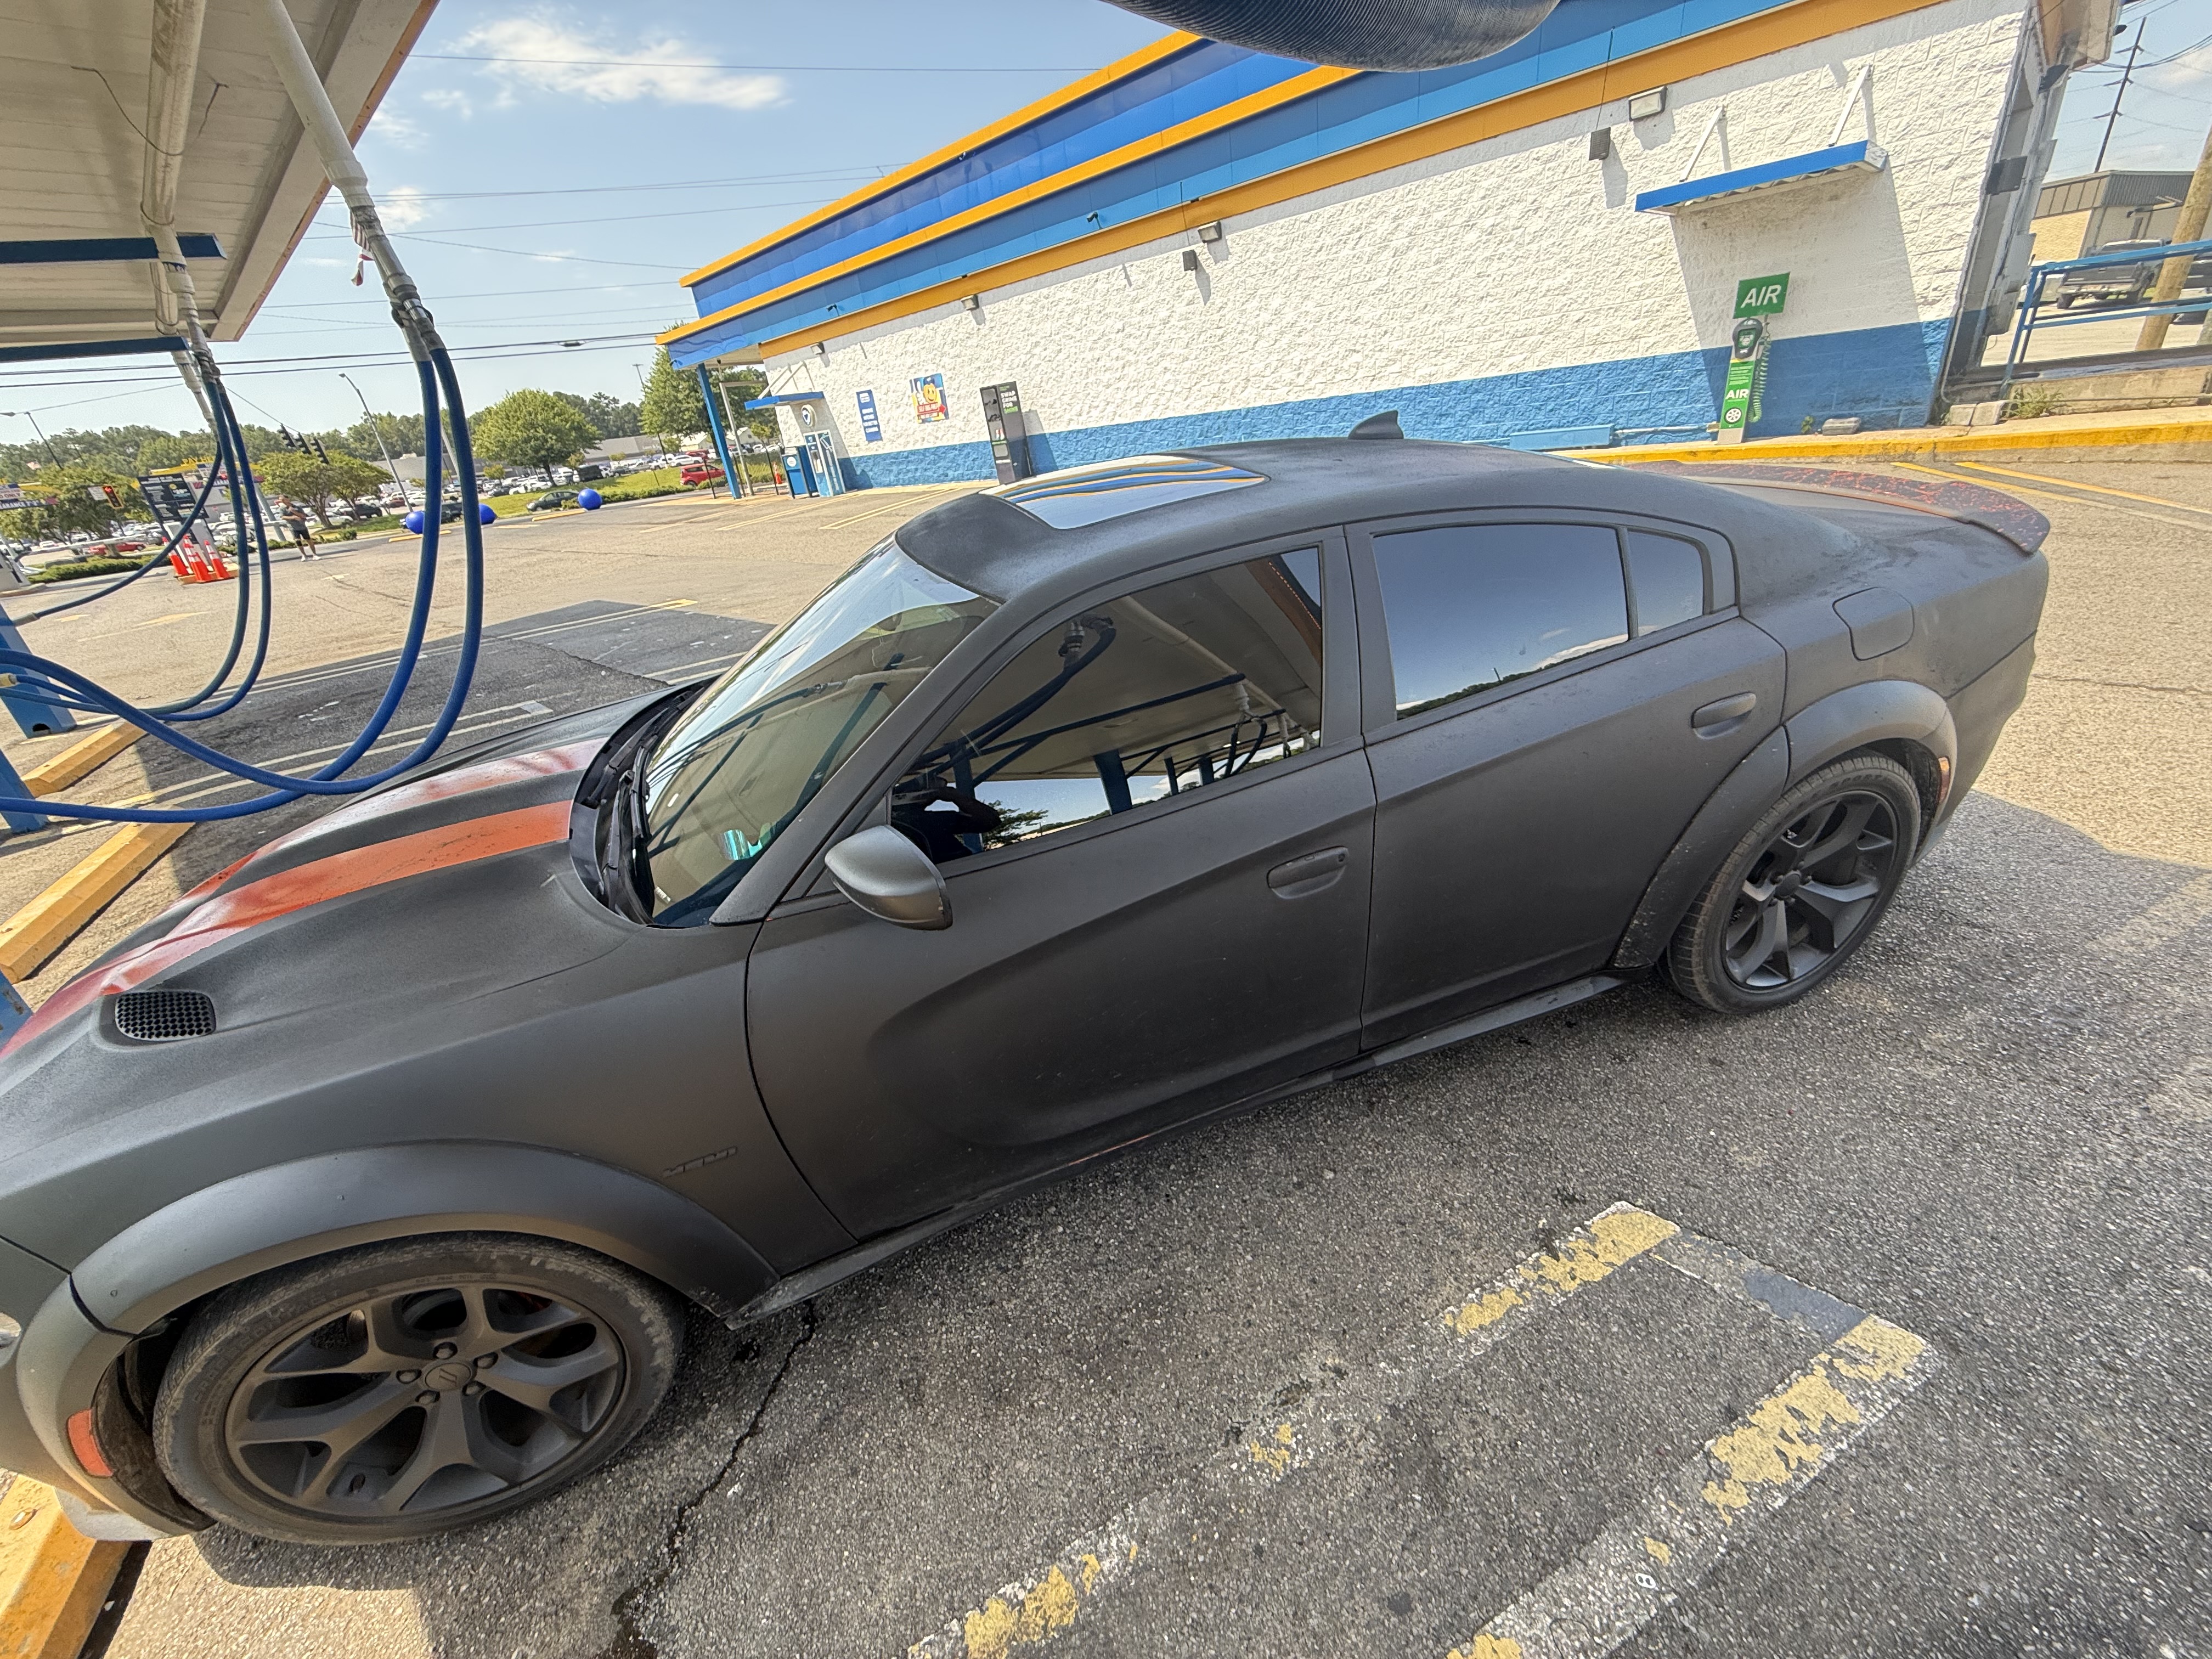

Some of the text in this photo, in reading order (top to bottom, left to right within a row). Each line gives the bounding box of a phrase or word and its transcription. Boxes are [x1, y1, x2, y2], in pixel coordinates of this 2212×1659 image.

[1740, 284, 1782, 308] AIR
[1001, 390, 1015, 398] SWAP
[1725, 388, 1749, 400] AIR
